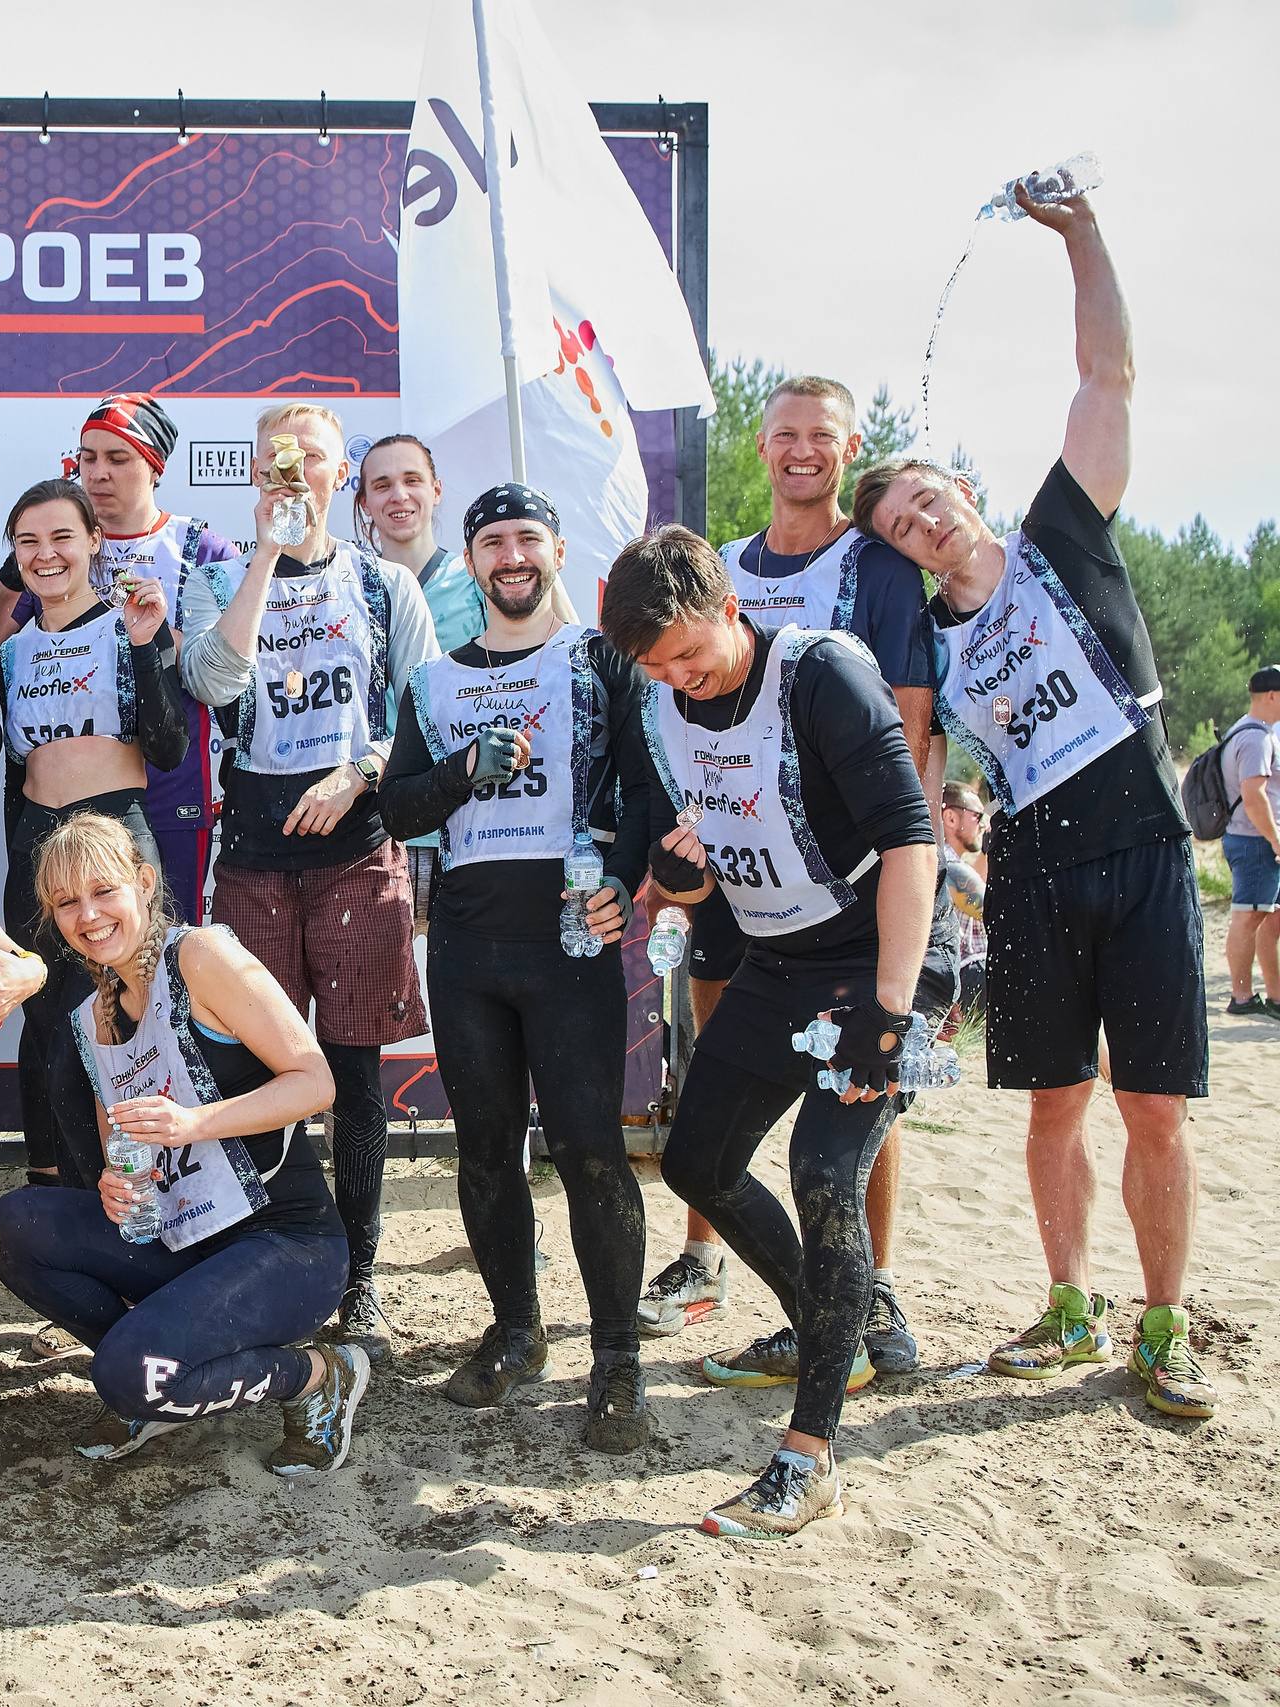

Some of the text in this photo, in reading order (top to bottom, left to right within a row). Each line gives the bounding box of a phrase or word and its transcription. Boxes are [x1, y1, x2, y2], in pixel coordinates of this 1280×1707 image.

[198, 469, 245, 477] KITCHEN
[266, 598, 298, 609] ГОНКА
[738, 596, 805, 607] ГОНКА ГЕРОЕВ
[31, 645, 90, 662] ГОНКА ГЕРОЕВ
[266, 665, 353, 720] 5326
[458, 677, 538, 696] ГОНКА ГЕРОЕВ
[296, 732, 352, 750] ГАЗПРОМБАНК
[1040, 725, 1100, 770] ГАЗПРОМБАНК
[477, 825, 546, 841] ГАЗПРОМБАНК
[704, 843, 783, 889] 5331
[742, 904, 804, 920] ГАЗПРОМБАНК
